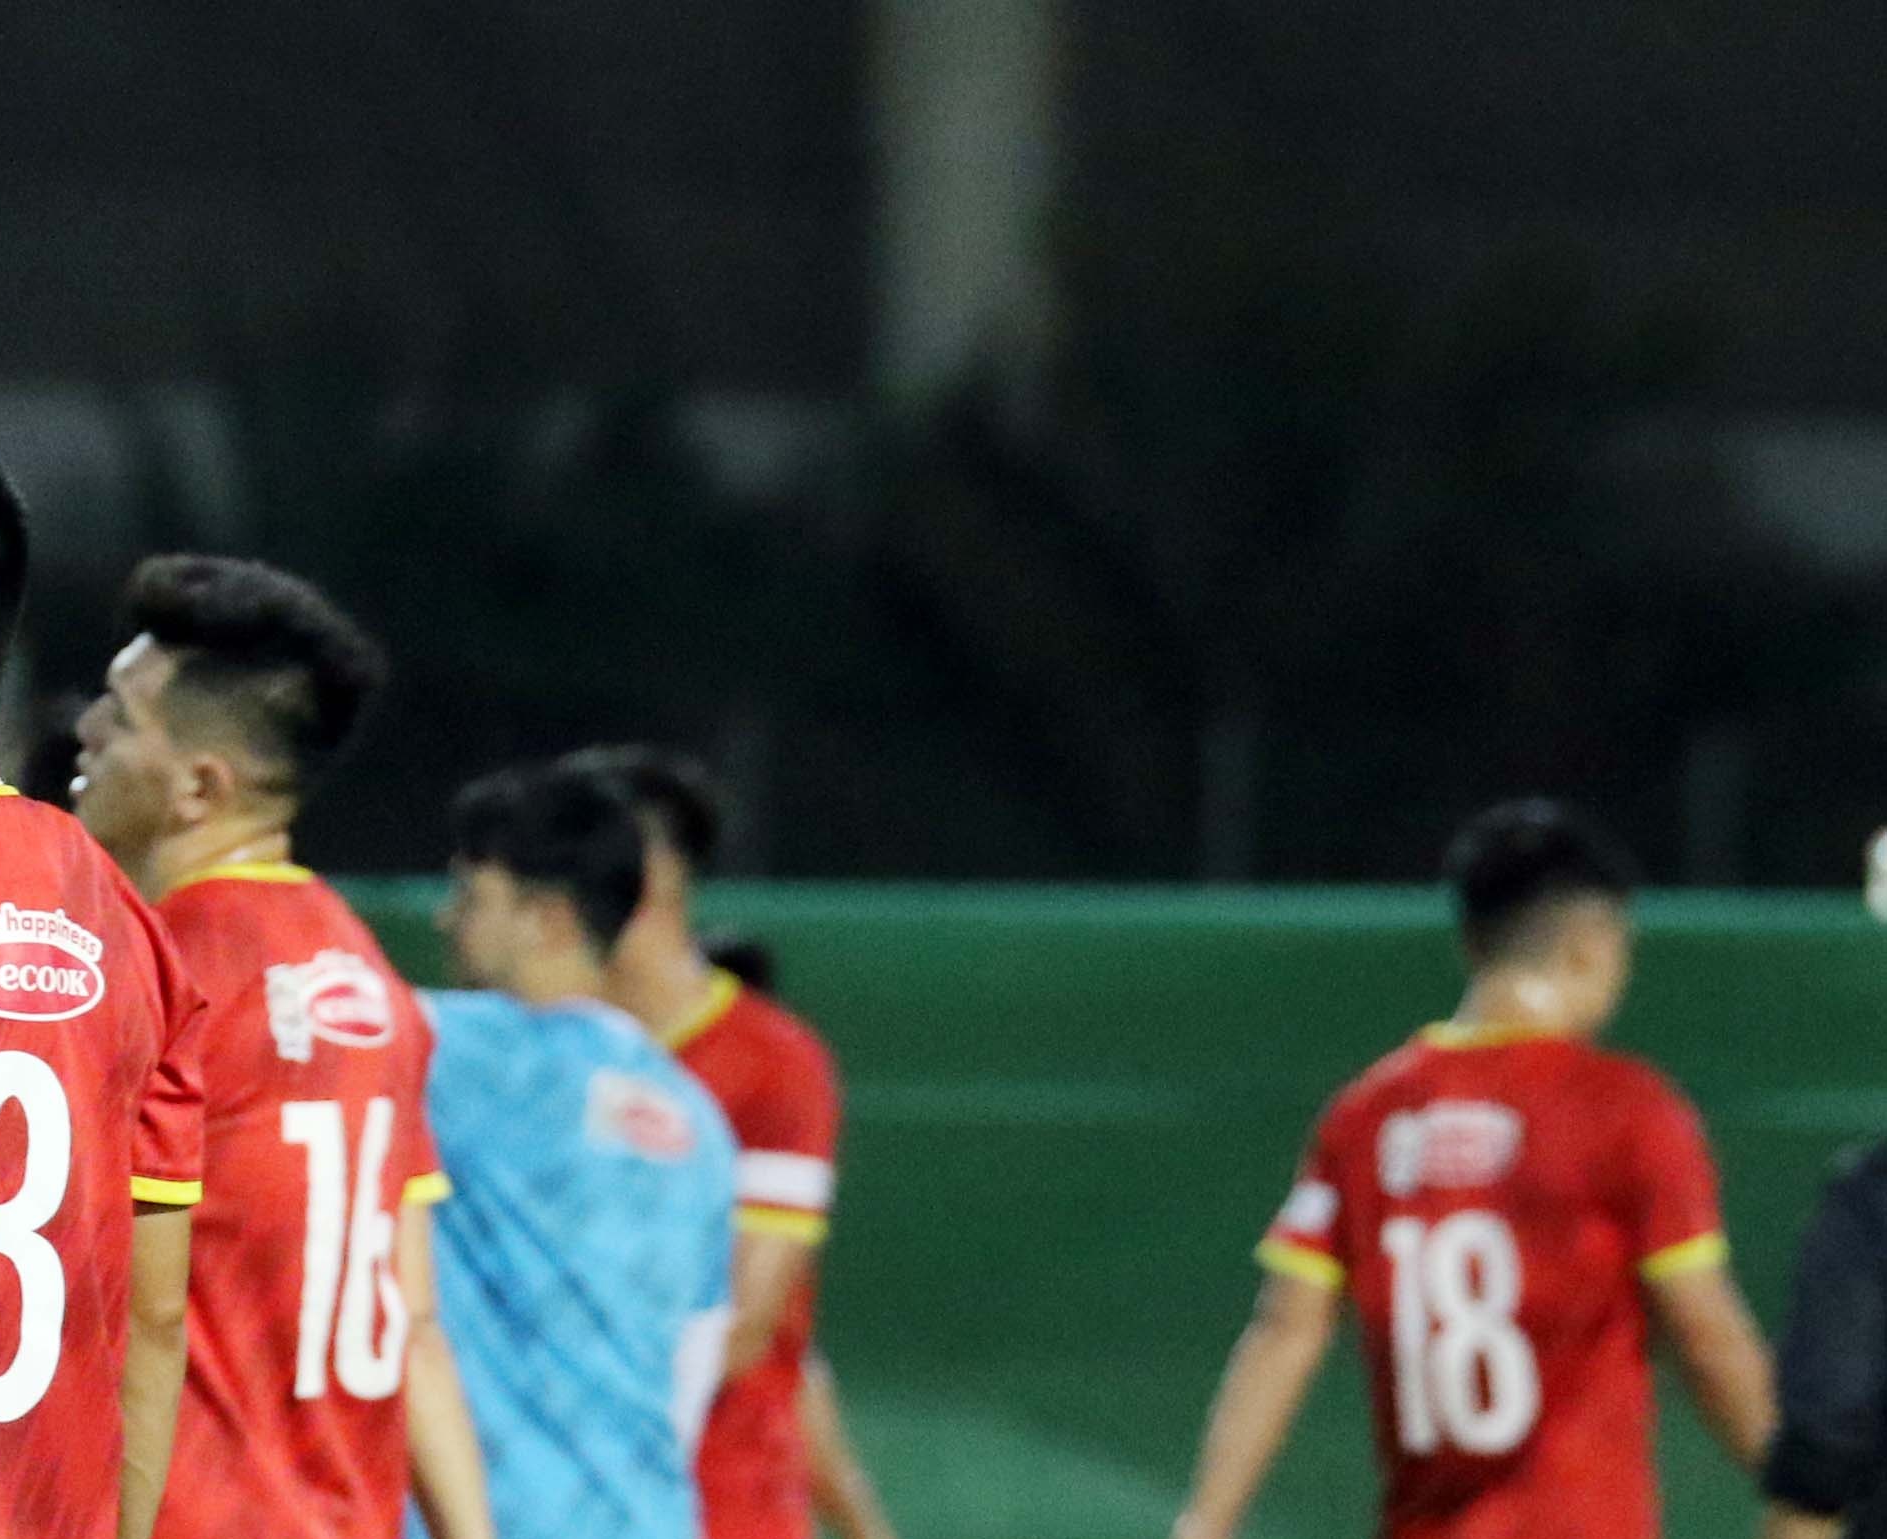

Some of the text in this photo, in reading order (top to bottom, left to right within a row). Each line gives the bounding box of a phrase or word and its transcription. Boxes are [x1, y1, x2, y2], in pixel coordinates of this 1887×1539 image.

[6, 908, 97, 956] happiness
[281, 1096, 407, 1399] 16
[1380, 1209, 1543, 1456] 18
